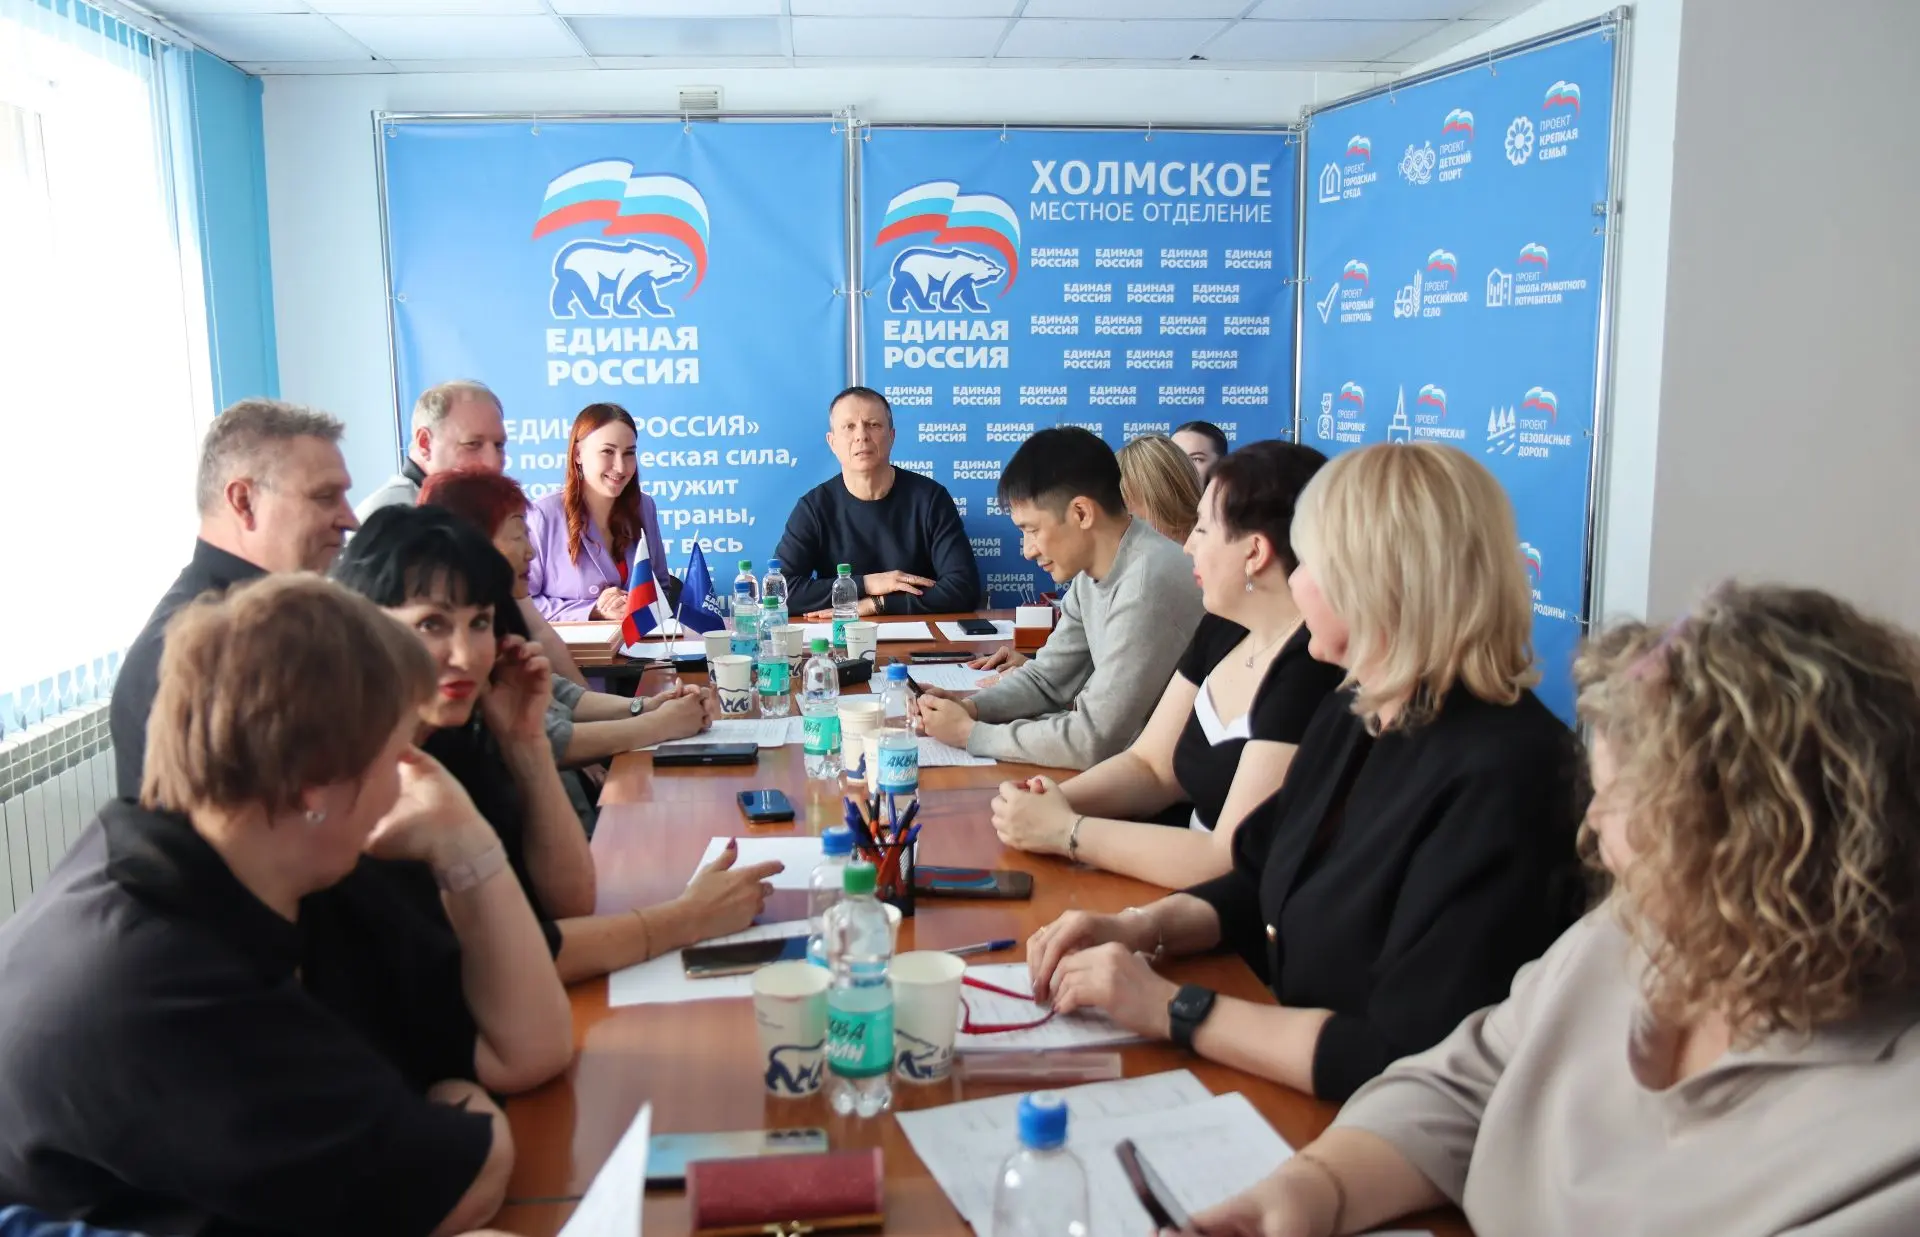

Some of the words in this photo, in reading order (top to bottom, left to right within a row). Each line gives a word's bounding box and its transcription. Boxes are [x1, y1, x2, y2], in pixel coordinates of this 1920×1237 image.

[1540, 115, 1571, 131] ПРОЕКТ
[1540, 128, 1578, 146] КРЕПКАЯ
[1440, 140, 1465, 155] ПРОЕКТ
[1539, 145, 1567, 160] СЕМЬЯ
[1439, 150, 1472, 170] ДЕТСКИЙ
[1031, 160, 1271, 196] ХОЛМСКОЕ
[1439, 168, 1463, 182] СПОРТ
[1343, 187, 1361, 199] СРЕДА
[1031, 201, 1133, 221] МЕСТНОЕ
[1144, 203, 1272, 225] ОТДЕЛЕНИЕ
[1031, 249, 1079, 258] ЕДИНАЯ
[1096, 249, 1143, 258] ЕДИНАЯ
[1161, 249, 1208, 258] ЕДИНАЯ
[1225, 249, 1271, 258] ЕДИНАЯ
[1031, 259, 1079, 268] РОССИЯ
[1096, 259, 1143, 268] РОССИЯ
[1161, 259, 1208, 268] РОССИЯ
[1225, 259, 1271, 268] РОССИЯ
[1064, 284, 1111, 293] ЕДИНАЯ
[1127, 284, 1175, 293] ЕДИНАЯ
[1193, 284, 1239, 293] ЕДИНАЯ
[1064, 294, 1111, 303] РОССИЯ
[1127, 294, 1175, 303] РОССИЯ
[1193, 294, 1239, 303] РОССИЯ
[1424, 291, 1468, 305] РОССИЙСКОЕ
[1423, 307, 1441, 317] СЕЛО
[1031, 316, 1078, 325] ЕДИНАЯ
[1095, 316, 1142, 325] ЕДИНАЯ
[1160, 316, 1207, 325] ЕДИНАЯ
[1224, 316, 1269, 325] ЕДИНАЯ
[884, 321, 1008, 341] ЕДИНАЯ
[1031, 326, 1078, 335] РОССИЯ
[1095, 326, 1142, 335] РОССИЯ
[1160, 326, 1207, 335] РОССИЯ
[1224, 326, 1269, 335] РОССИЯ
[546, 327, 699, 355] ЕДИНАЯ
[884, 347, 1008, 368] РОССИЯ
[1064, 351, 1111, 360] ЕДИНАЯ
[1126, 351, 1173, 360] ЕДИНАЯ
[1192, 351, 1237, 360] ЕДИНАЯ
[1064, 360, 1111, 369] РОССИЯ
[1126, 360, 1173, 369] РОССИЯ
[1192, 360, 1237, 369] РОССИЯ
[547, 358, 700, 386] РОССИЯ
[885, 387, 933, 395] ЕДИНАЯ
[953, 387, 1001, 395] ЕДИНАЯ
[1020, 387, 1067, 395] ЕДИНАЯ
[1090, 387, 1136, 395] ЕДИНАЯ
[1159, 387, 1204, 395] ЕДИНАЯ
[1222, 387, 1268, 395] ЕДИНАЯ
[953, 396, 1001, 405] РОССИЯ
[1020, 396, 1067, 405] РОССИЯ
[1090, 396, 1136, 405] РОССИЯ
[1159, 396, 1204, 405] РОССИЯ
[1222, 396, 1268, 405] РОССИЯ
[919, 423, 967, 433] ЕДИНАЯ
[987, 423, 1034, 433] ЕДИНАЯ
[1123, 423, 1170, 432] ЕДИНАЯ
[1520, 419, 1548, 431] ПРОЕКТ
[504, 418, 572, 445] ЕДИН
[1415, 426, 1466, 439] ИСТОРИЧЕСКАЯ
[919, 433, 967, 442] РОССИЯ
[1520, 432, 1572, 446] БЕЗОПАСНЫЕ
[1518, 446, 1549, 458] ДОРОГИ
[726, 448, 797, 467] сила,
[890, 461, 933, 470] ДИНАЯ
[953, 460, 1001, 470] ЕДИНАЯ
[953, 470, 1001, 480] РОССИЯ
[641, 478, 738, 502] служит
[656, 508, 756, 531] траны,
[681, 537, 743, 554] весь
[968, 538, 1001, 547] ИНАЯ
[986, 573, 1034, 583] ЕДИНАЯ
[986, 582, 1034, 592] РОССИЯ
[1533, 602, 1566, 619] РОДИНЫ
